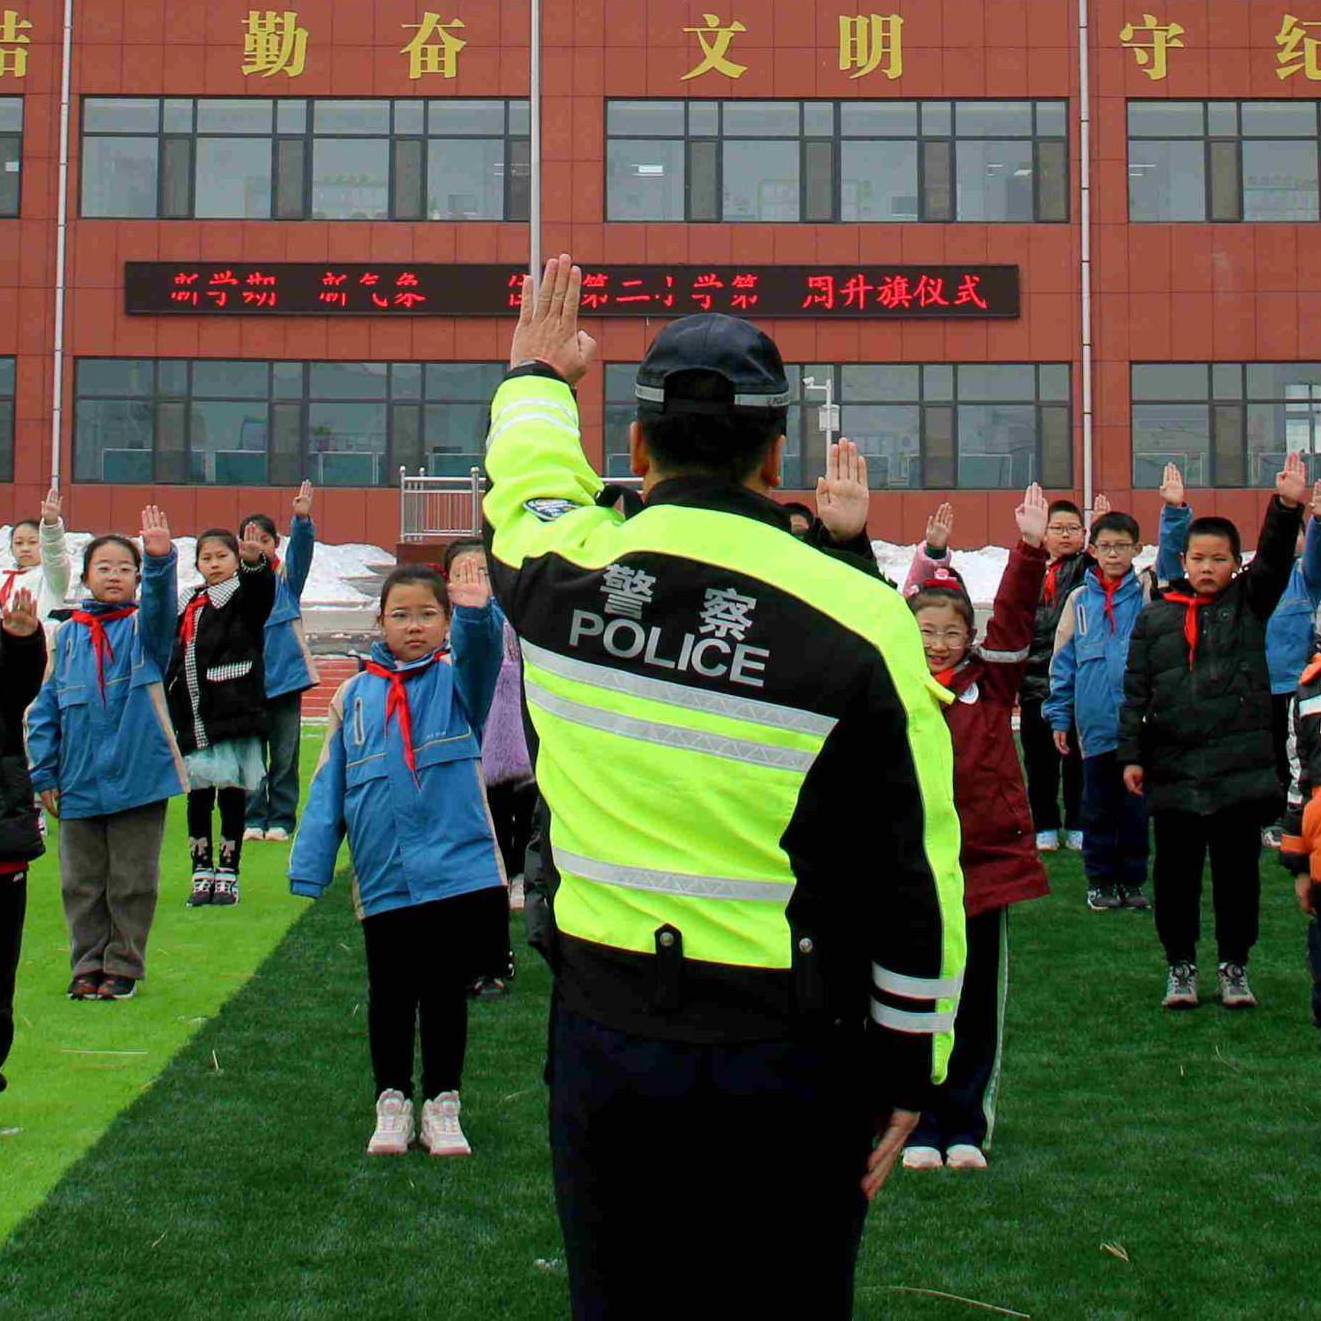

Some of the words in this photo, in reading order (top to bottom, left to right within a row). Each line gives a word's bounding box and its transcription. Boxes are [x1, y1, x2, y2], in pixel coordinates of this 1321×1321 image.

[241, 10, 468, 80] 勤奋
[682, 13, 905, 80] 文明
[599, 563, 758, 641] 警察
[569, 609, 770, 687] POLICE
